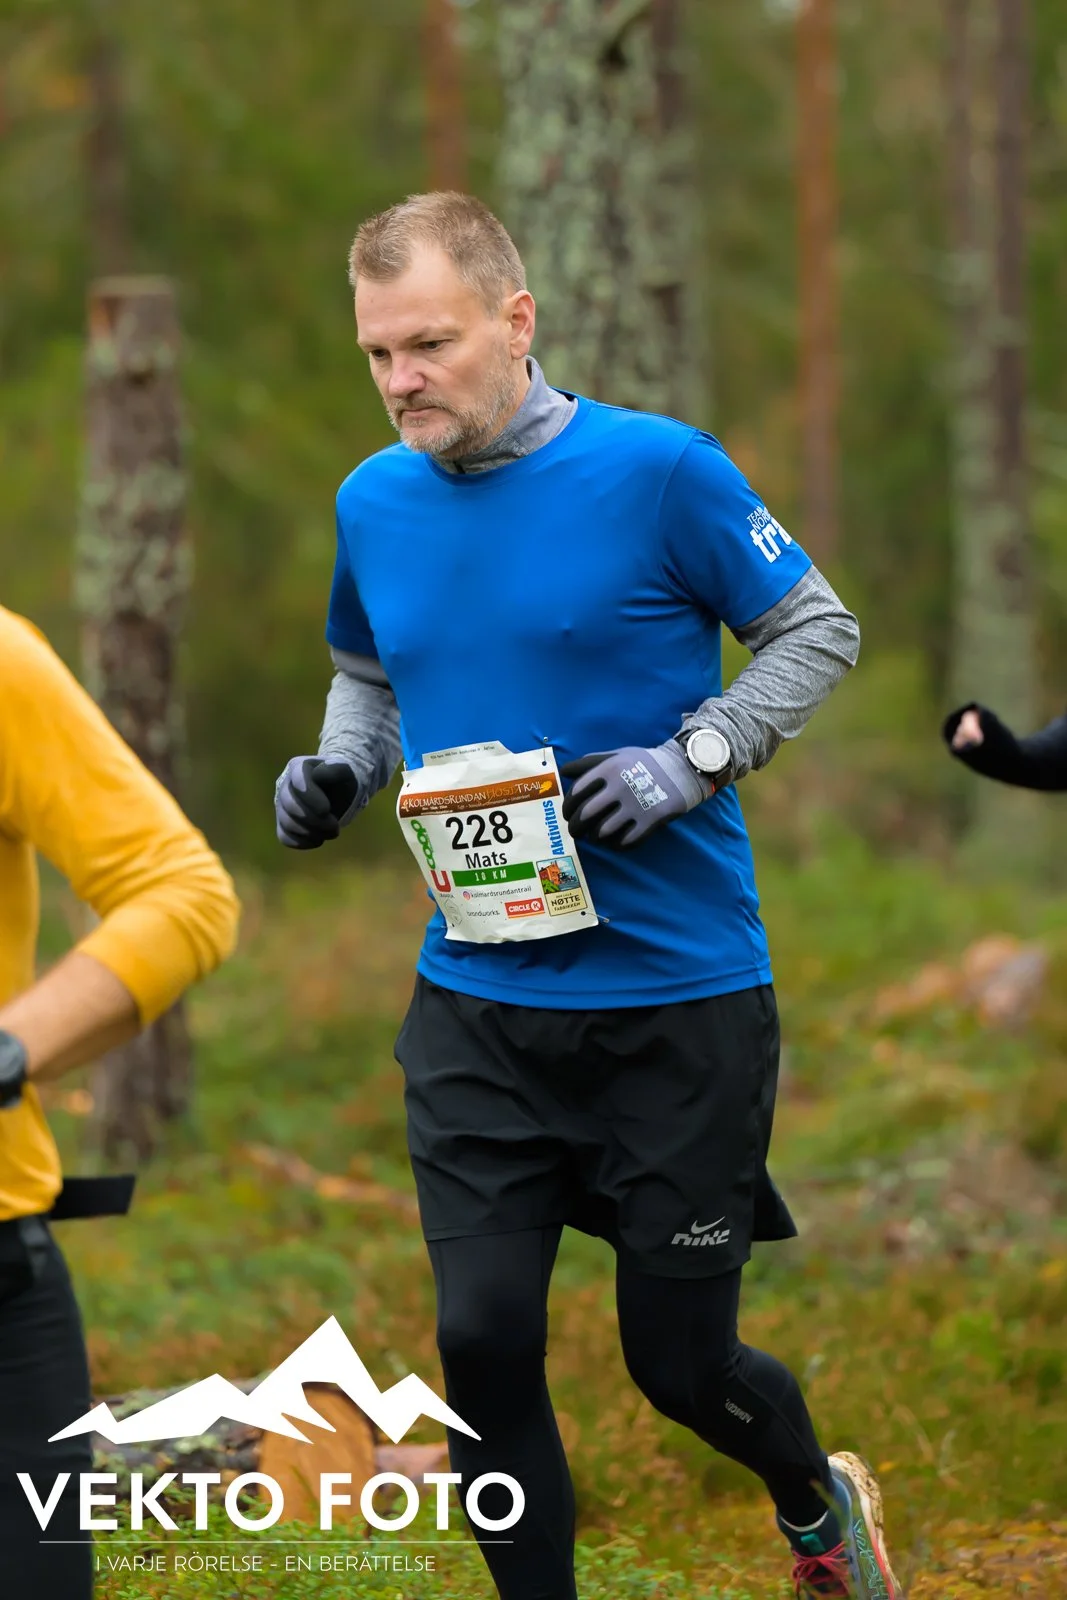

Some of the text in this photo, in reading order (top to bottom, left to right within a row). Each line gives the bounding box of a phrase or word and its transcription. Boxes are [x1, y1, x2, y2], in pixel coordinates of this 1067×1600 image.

[746, 505, 764, 524] TEAM
[514, 781, 542, 793] TRAIL
[445, 810, 513, 852] 228
[542, 799, 565, 856] Aktivitus
[410, 819, 436, 869] coop
[465, 851, 508, 870] Mats
[474, 869, 508, 882] 10 KM
[508, 903, 531, 913] CIRCLE
[551, 895, 580, 906] NØTTE
[671, 1229, 731, 1246] NIKE
